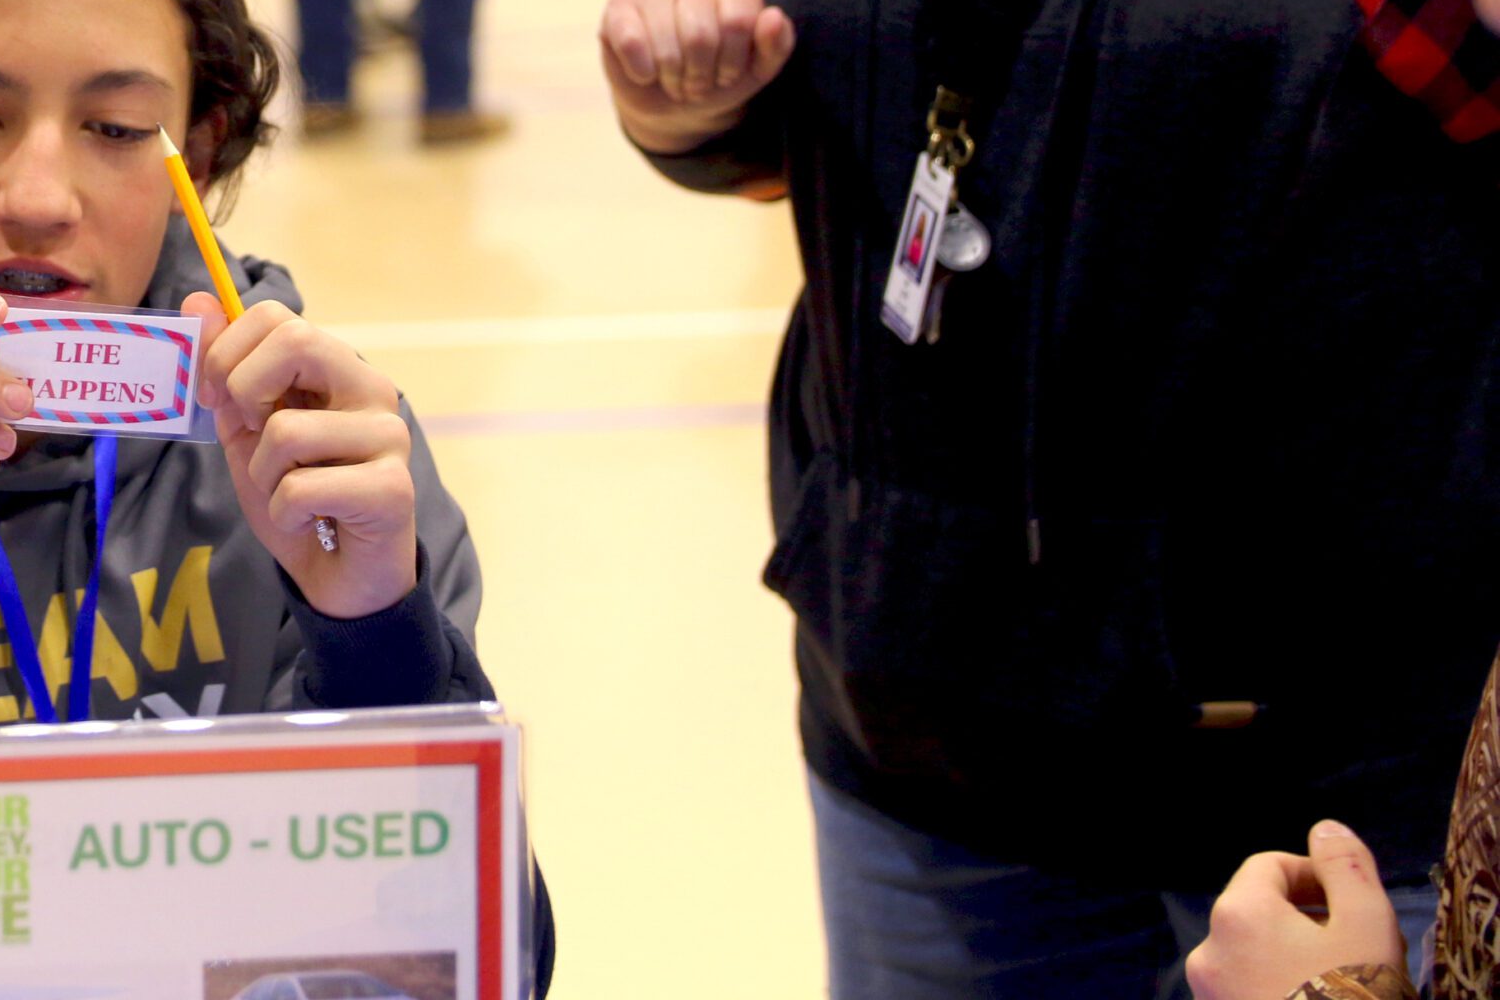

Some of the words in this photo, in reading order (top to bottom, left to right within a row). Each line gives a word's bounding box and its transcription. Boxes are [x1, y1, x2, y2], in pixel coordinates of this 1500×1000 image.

[54, 341, 121, 366] LIFE
[68, 818, 232, 871] AUTO
[250, 839, 269, 849] -
[289, 810, 450, 861] USED
